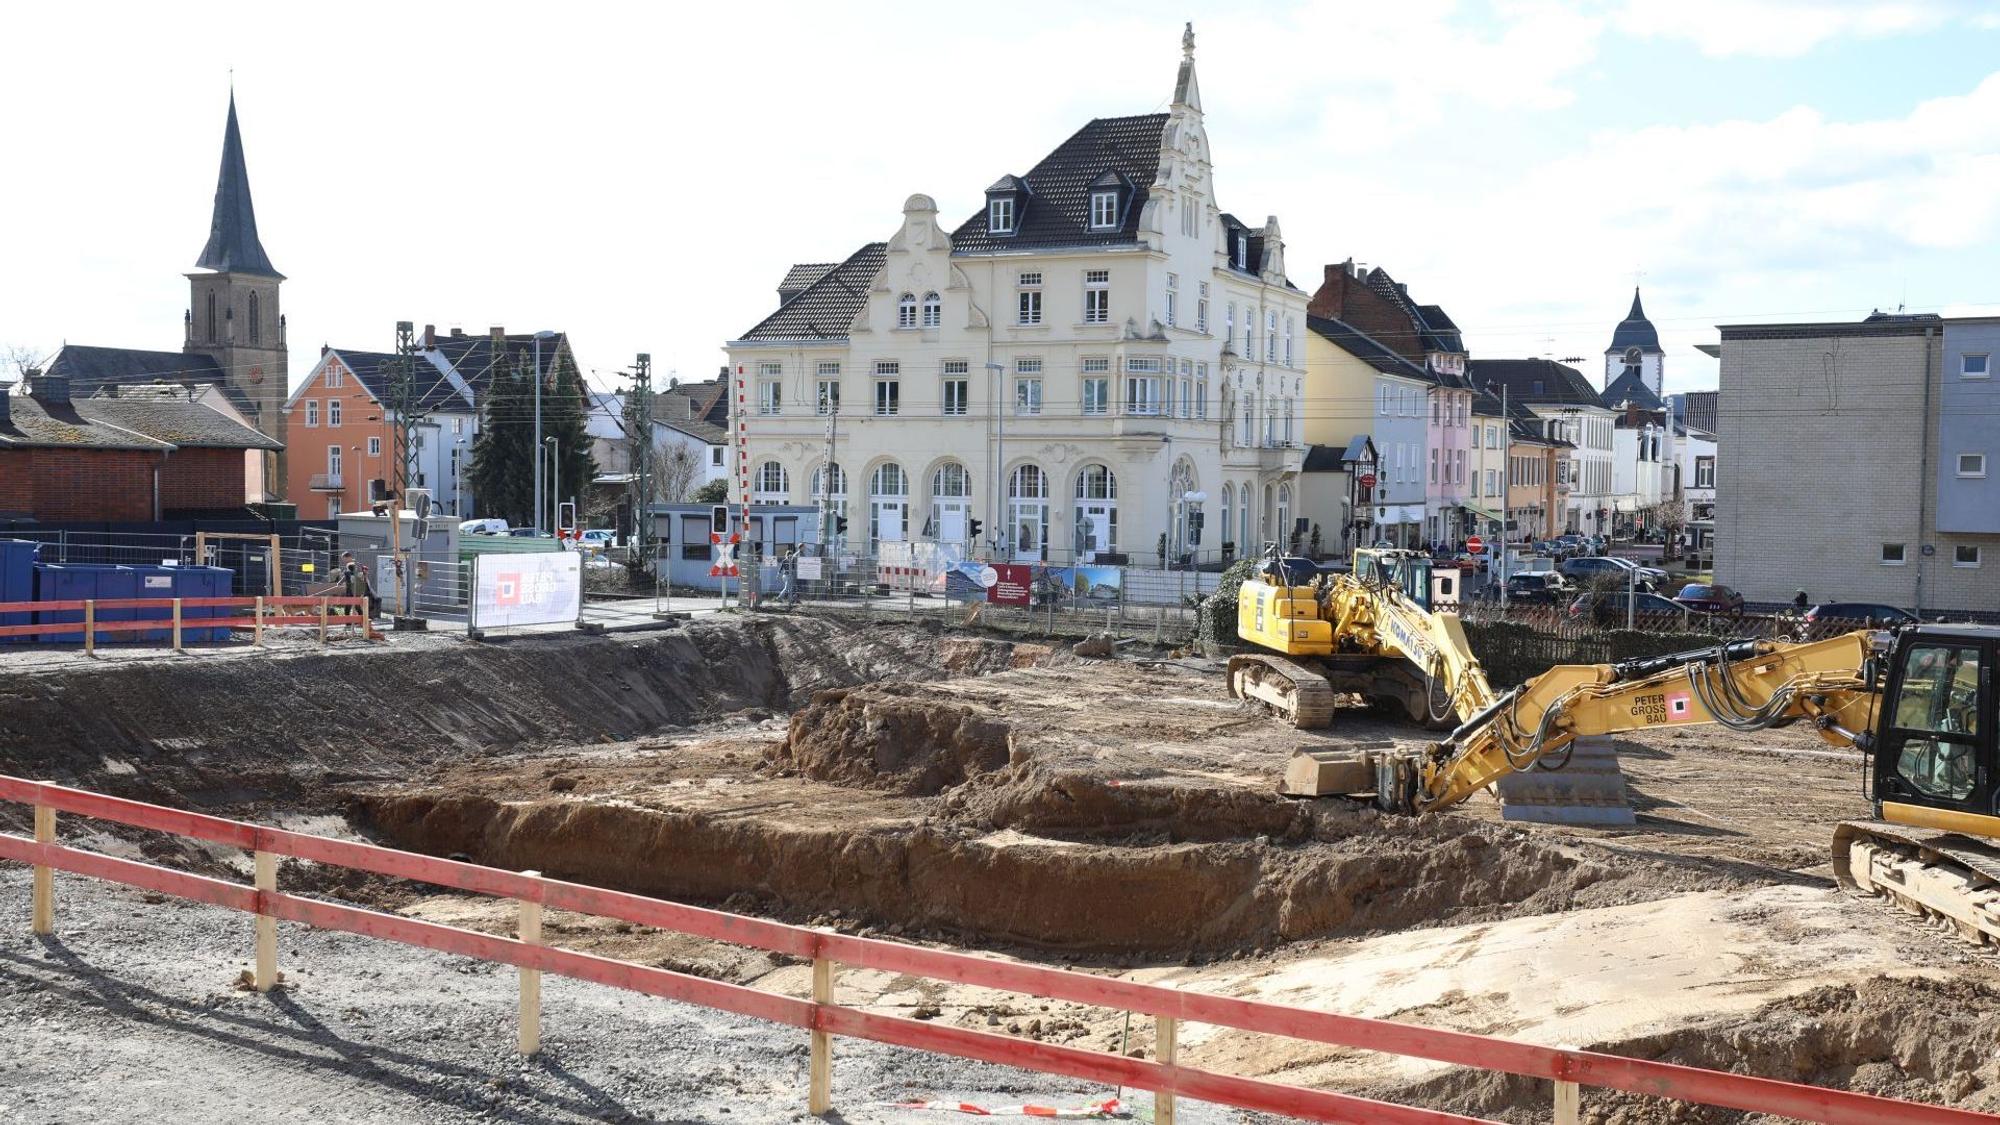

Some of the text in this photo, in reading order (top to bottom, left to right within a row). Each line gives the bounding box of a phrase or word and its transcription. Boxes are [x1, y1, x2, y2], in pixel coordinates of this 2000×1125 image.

[1390, 619, 1423, 660] KOMATSU
[1634, 694, 1665, 706] PETER
[1631, 704, 1666, 716] GROSS
[1646, 714, 1667, 724] BAU
